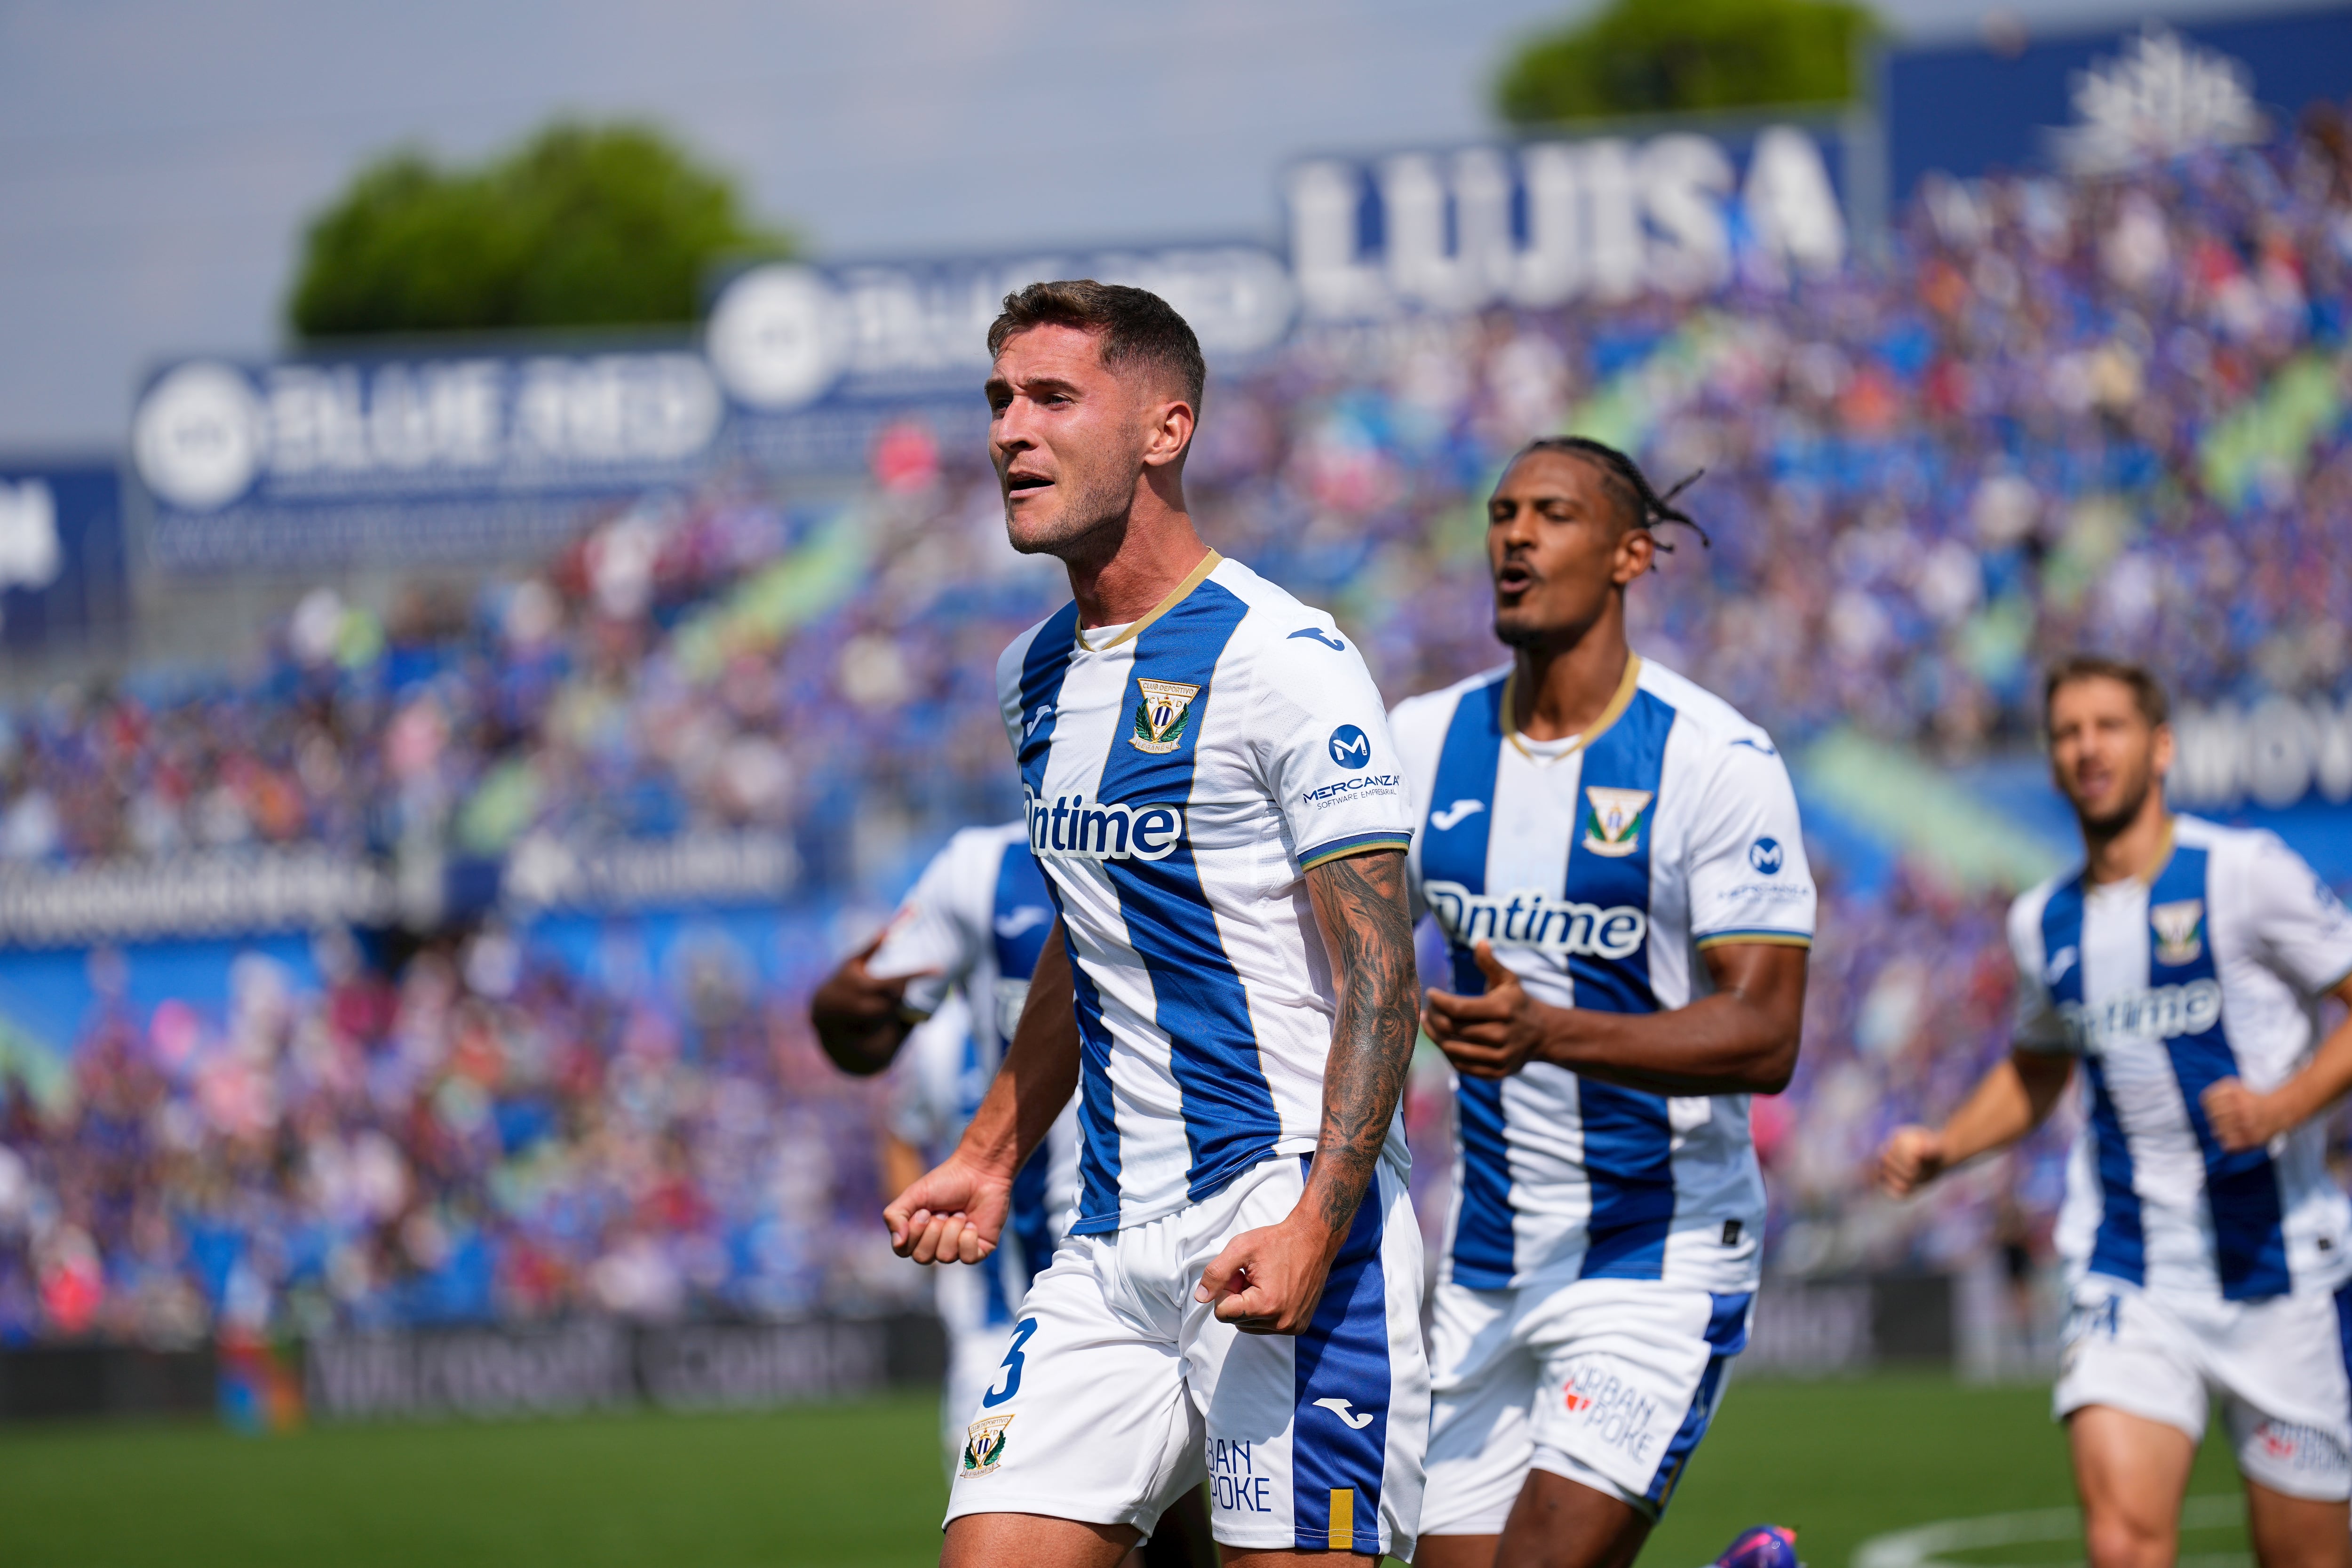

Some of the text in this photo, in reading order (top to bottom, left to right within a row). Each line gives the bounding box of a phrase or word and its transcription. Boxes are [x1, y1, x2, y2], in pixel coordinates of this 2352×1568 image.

[1290, 125, 1845, 308] LUISA
[267, 360, 501, 470] BLUE
[1160, 685, 1193, 695] DEPORTIVO
[1317, 788, 1397, 810] SOFTWARE EMPRESARIAL
[983, 1317, 1038, 1408] 3
[980, 1418, 1009, 1428] DEPORTIVO
[1206, 1437, 1251, 1474] BAN
[1210, 1473, 1271, 1512] POKE
